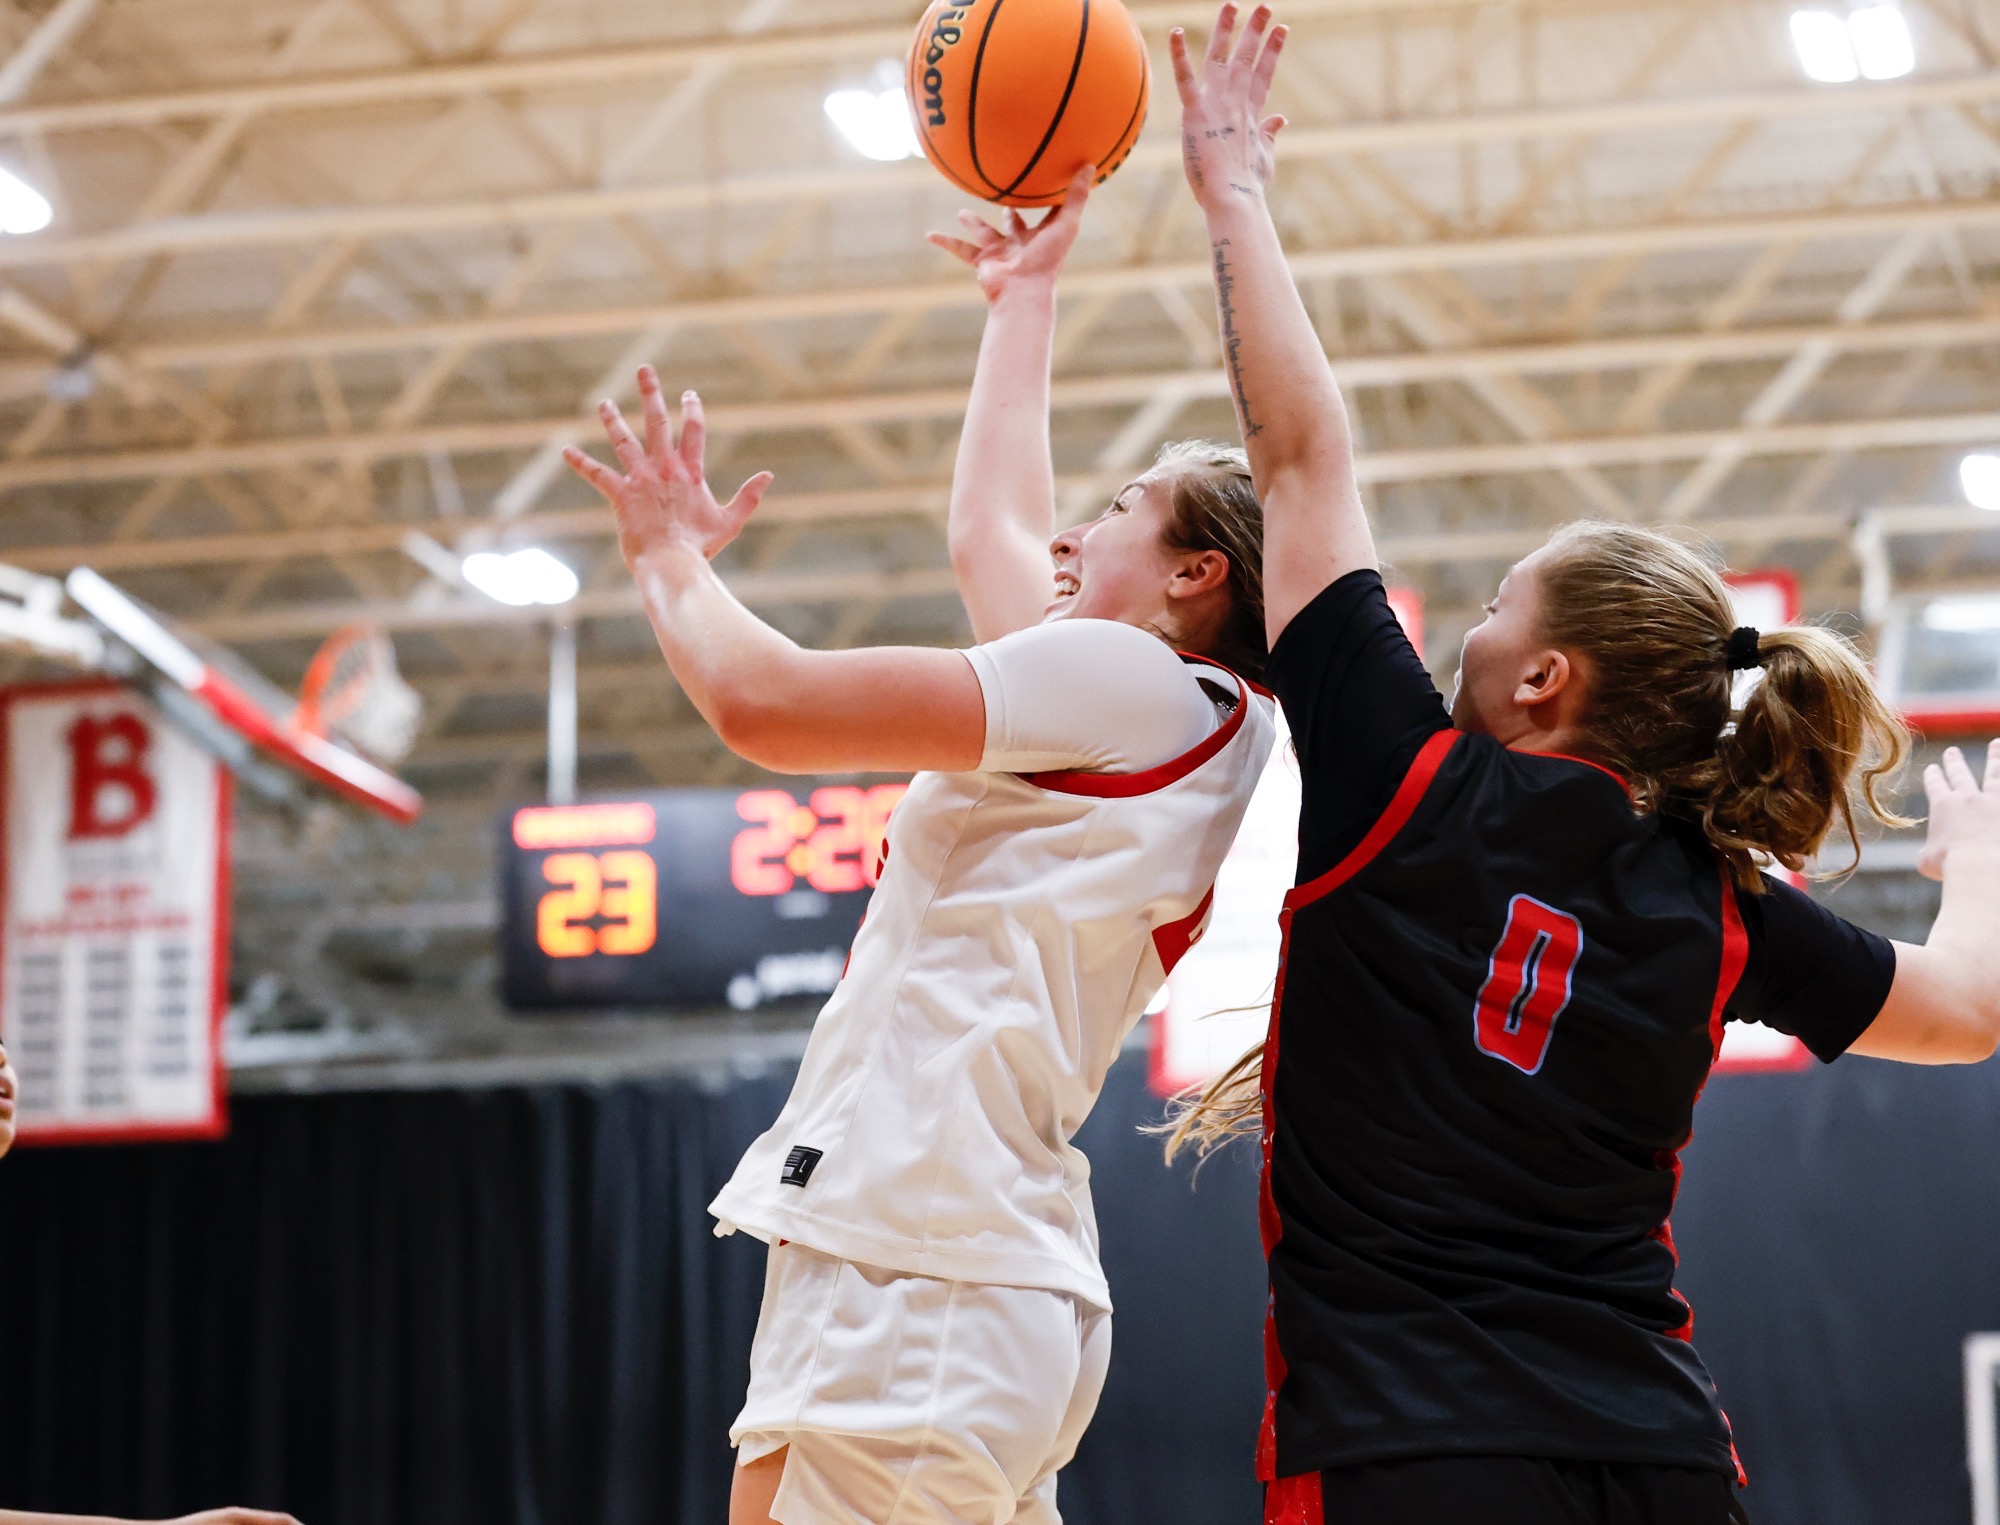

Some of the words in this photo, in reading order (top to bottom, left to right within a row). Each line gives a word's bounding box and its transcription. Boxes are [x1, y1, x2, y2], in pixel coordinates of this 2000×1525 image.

[923, 0, 976, 127] ilson
[66, 711, 158, 841] B
[537, 850, 657, 958] 23
[1474, 893, 1584, 1076] 0
